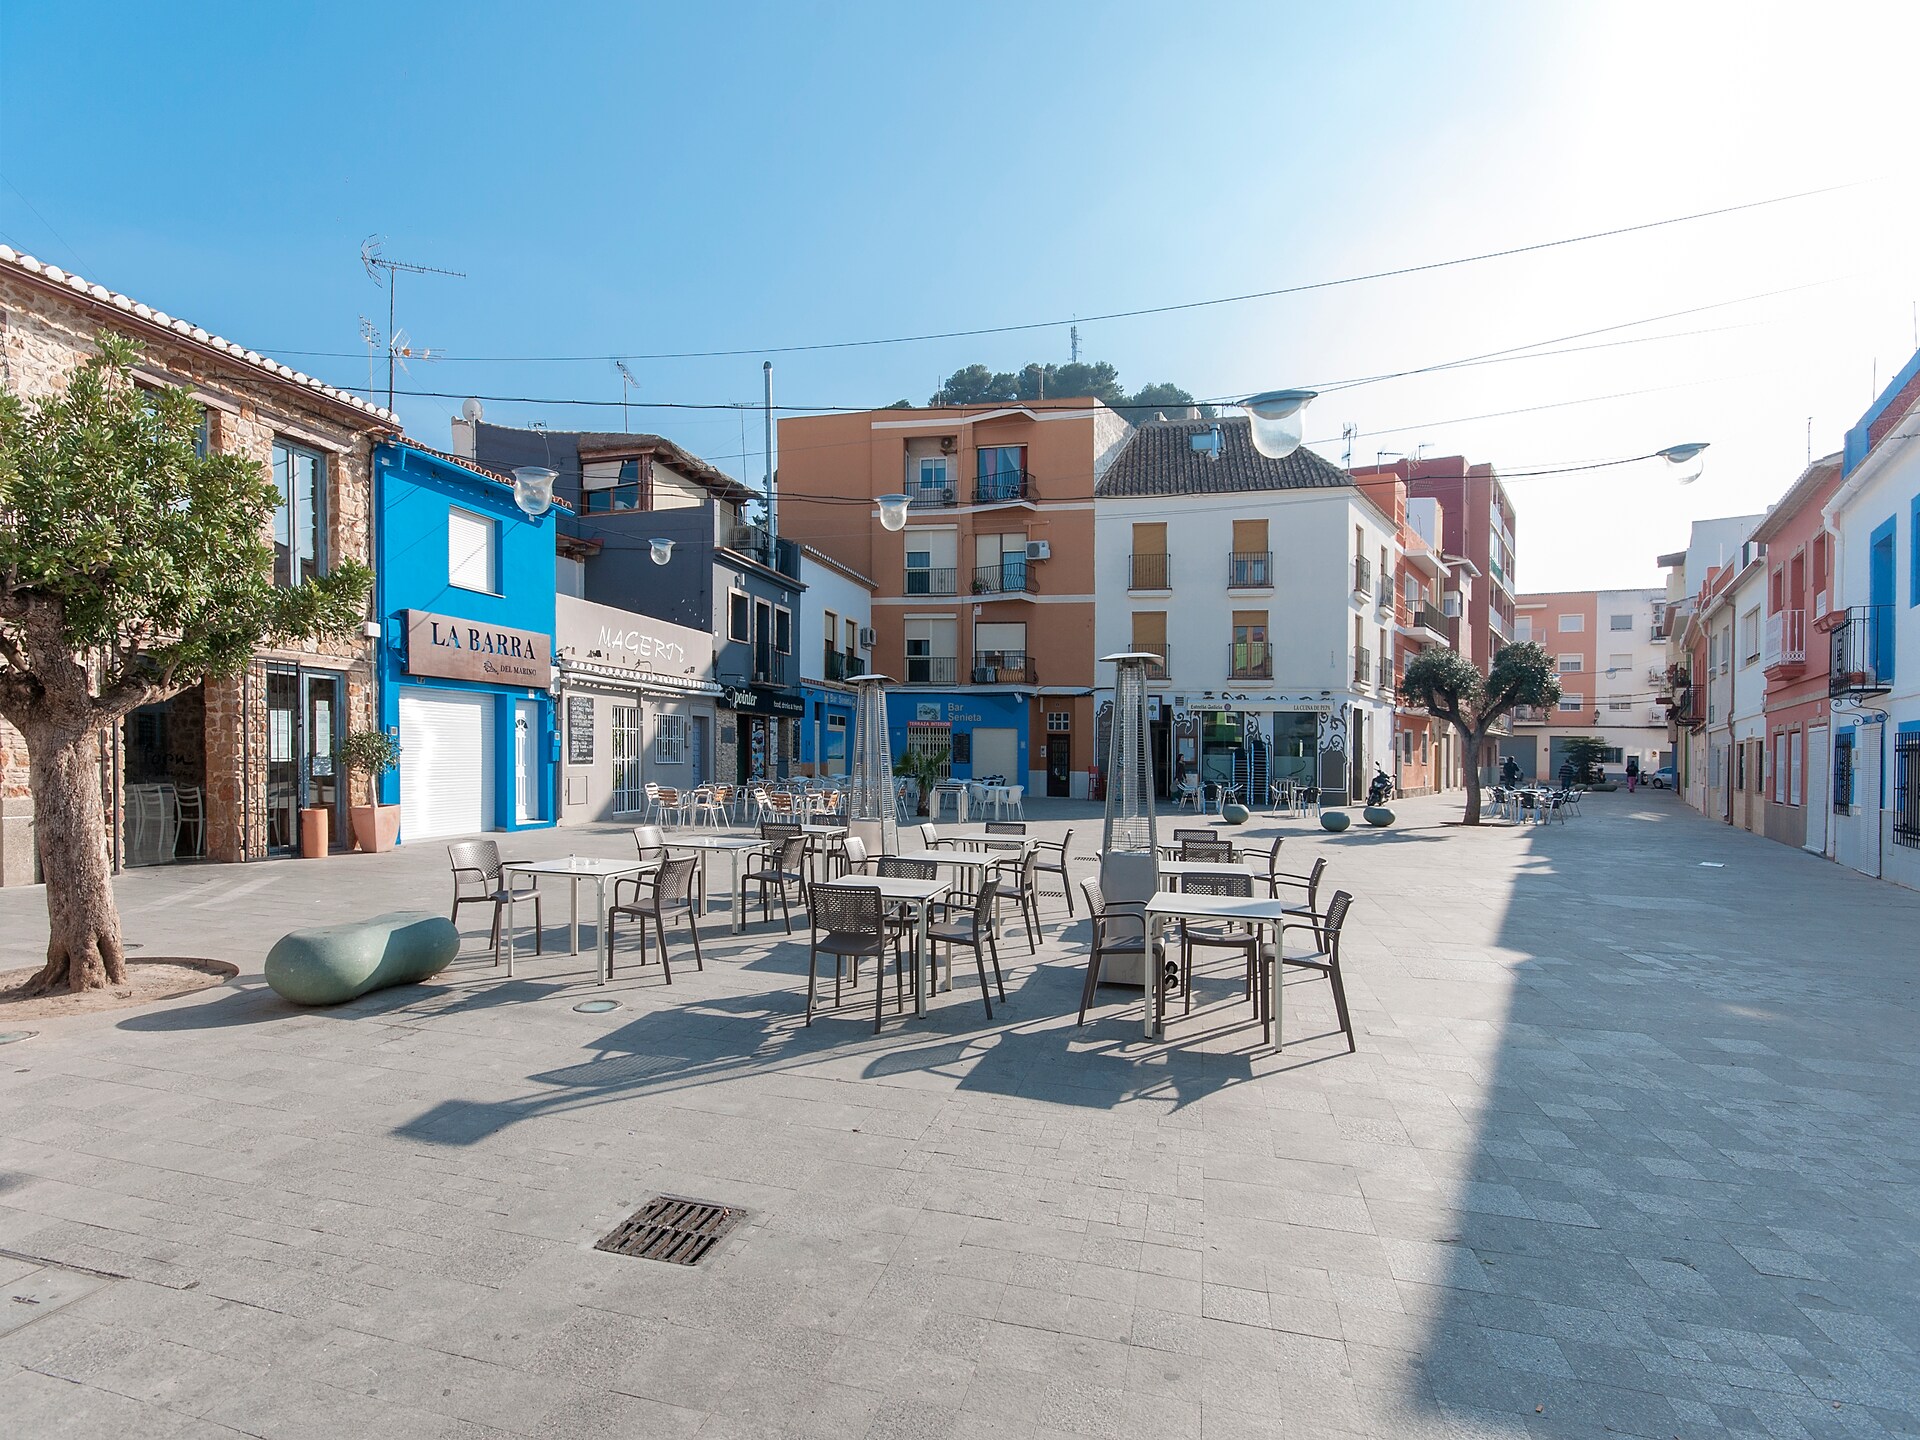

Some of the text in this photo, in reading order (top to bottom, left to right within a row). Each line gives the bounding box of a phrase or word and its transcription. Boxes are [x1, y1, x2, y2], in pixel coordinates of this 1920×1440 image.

[430, 621, 536, 660] LA BARRA
[500, 664, 537, 676] DEL MARINO
[734, 689, 758, 709] pointer
[948, 702, 964, 712] Bar
[948, 713, 982, 722] Senieta
